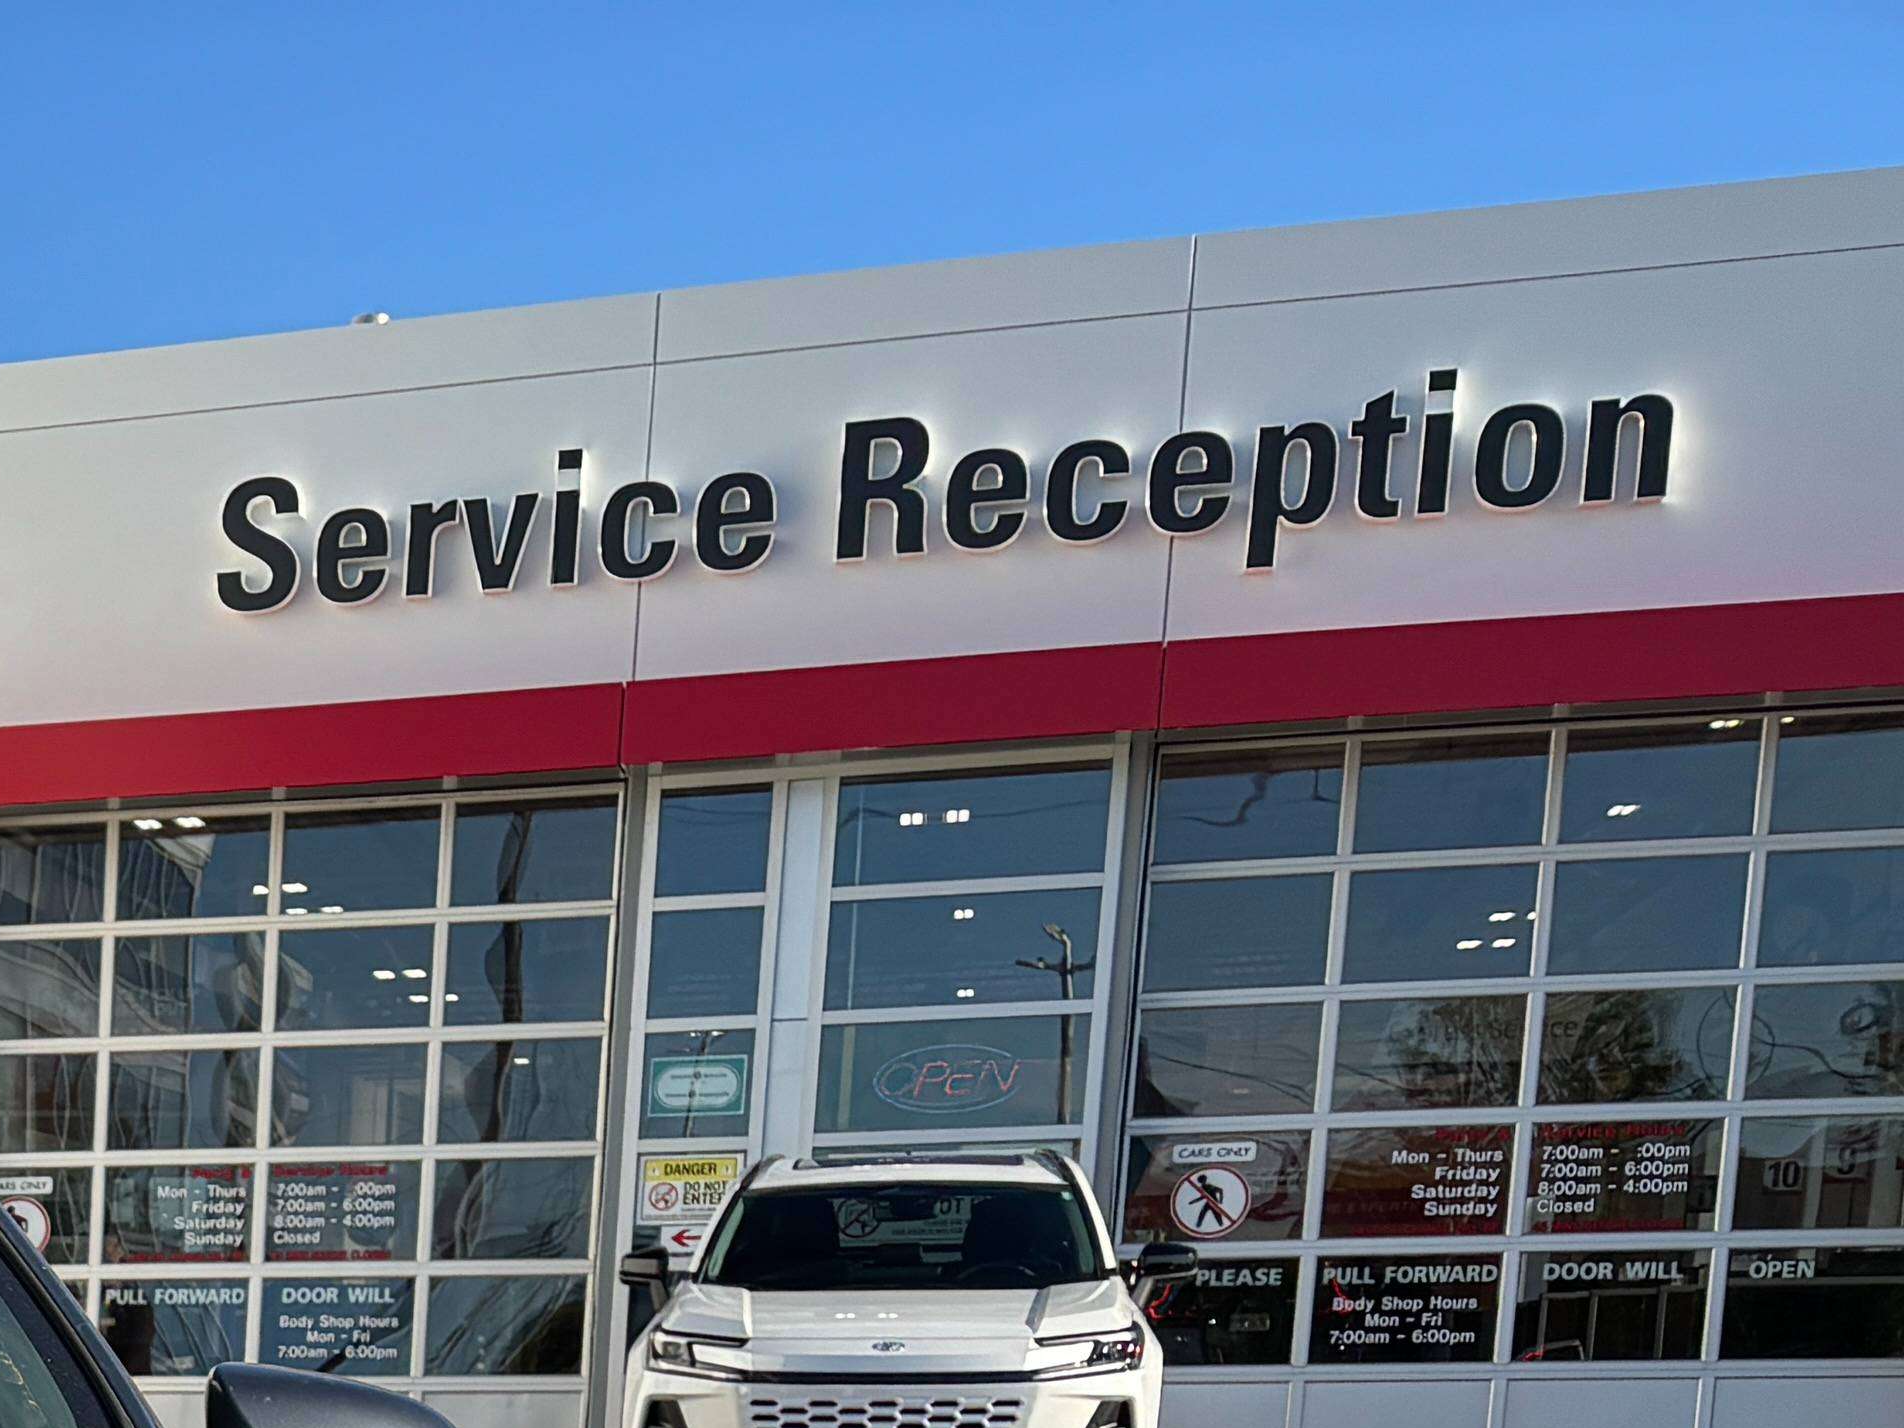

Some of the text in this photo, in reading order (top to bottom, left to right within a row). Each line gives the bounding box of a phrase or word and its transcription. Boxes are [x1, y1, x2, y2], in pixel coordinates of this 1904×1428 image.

[216, 368, 1676, 614] Service Reception
[880, 1059, 1023, 1098] OPEN
[1392, 1150, 1429, 1165] Mon
[1456, 1149, 1504, 1163] Thurs
[1542, 1146, 1603, 1160] 7:00am
[664, 1162, 718, 1177] DANGER
[1434, 1166, 1501, 1182] Friday
[1540, 1163, 1602, 1178] 7:00am
[1624, 1161, 1688, 1177] 6:00pm
[1769, 1160, 1800, 1187] 10
[157, 1185, 188, 1199] Mon
[207, 1184, 247, 1198] Thurs
[276, 1182, 327, 1197] 7:00am
[683, 1181, 700, 1192] DO
[1411, 1184, 1500, 1200] Saturday
[1538, 1180, 1601, 1196] 8:00am
[1623, 1179, 1687, 1195] 4:00pm
[191, 1200, 245, 1215] Friday
[276, 1198, 326, 1212] 7:00am
[342, 1198, 396, 1214] 6:00pm
[1424, 1202, 1498, 1218] Sunday
[1537, 1198, 1595, 1213] Closed
[174, 1215, 245, 1231] Saturday
[342, 1213, 395, 1230] 4:00pm
[184, 1231, 244, 1247] Sunday
[273, 1230, 321, 1244] Closed
[1195, 1260, 1816, 1288] PLEASE PULL FORWARD DOOR WILL OPEN
[105, 1286, 396, 1306] PULL FORWARD DOOR WILL
[1332, 1295, 1478, 1313] Body Shop Hours
[279, 1314, 399, 1331] Body Shop Hours
[1364, 1313, 1399, 1328] Mon
[1420, 1312, 1443, 1327] Fri
[307, 1330, 336, 1344] Mon
[352, 1329, 371, 1343] Fri
[1329, 1330, 1390, 1345] 7:00am
[1411, 1329, 1475, 1346] 6:00pm
[277, 1345, 328, 1360] 7:00am
[345, 1345, 398, 1361] 6:00pm
